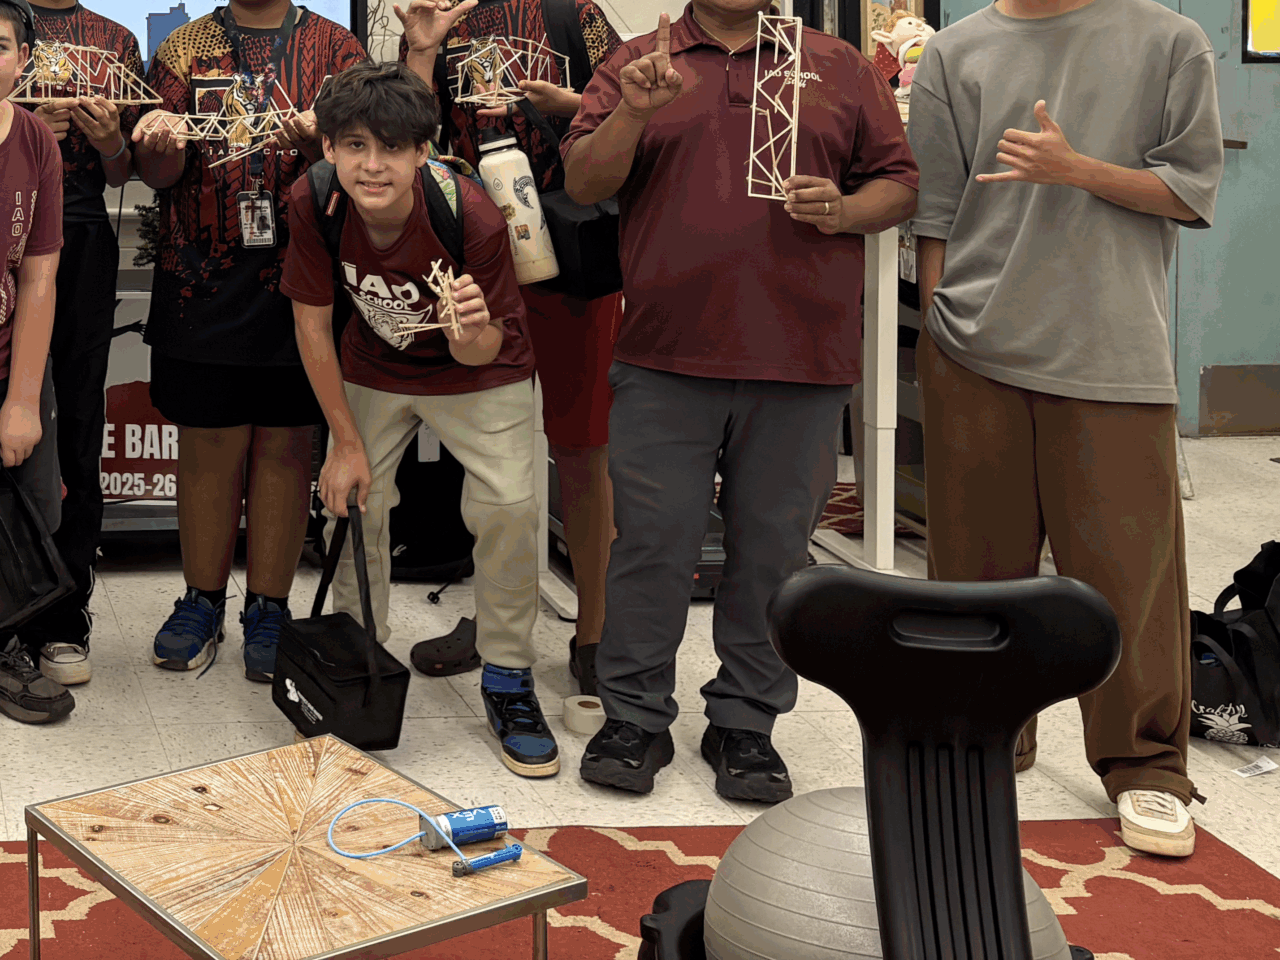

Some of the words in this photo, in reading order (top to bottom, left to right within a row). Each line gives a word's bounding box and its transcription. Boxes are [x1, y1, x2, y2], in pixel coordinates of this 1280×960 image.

[764, 69, 782, 77] IAO
[784, 70, 823, 82] SCHOOL
[12, 191, 24, 236] IAO
[358, 290, 412, 311] SCHOOL
[125, 423, 179, 460] BAR
[100, 472, 177, 496] 2025-26
[450, 808, 486, 821] VEX
